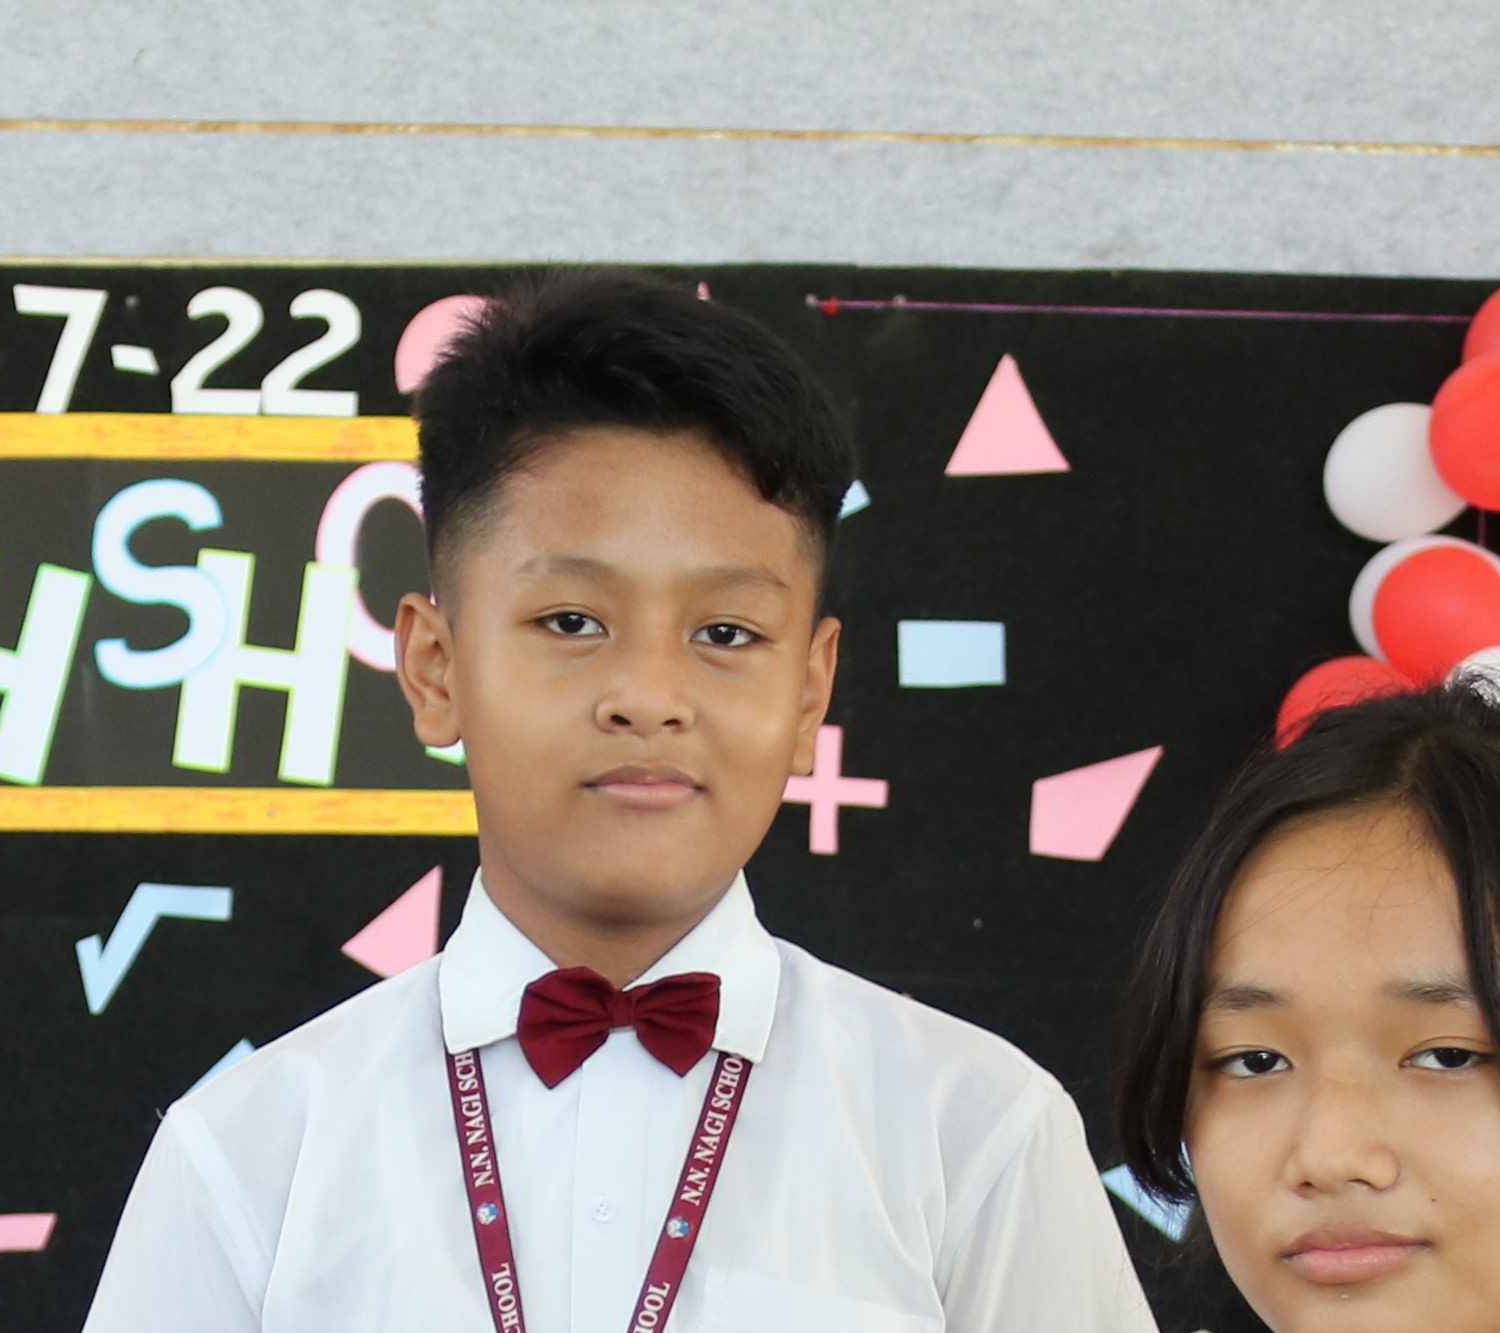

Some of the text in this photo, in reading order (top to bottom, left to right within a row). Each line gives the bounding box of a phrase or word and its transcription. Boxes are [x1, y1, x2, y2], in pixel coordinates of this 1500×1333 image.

[92, 460, 466, 787] SHO
[455, 1051, 478, 1091] SCH
[694, 1111, 728, 1164] NAGI
[711, 1054, 743, 1110] SCHO
[461, 1095, 487, 1145] NAGI
